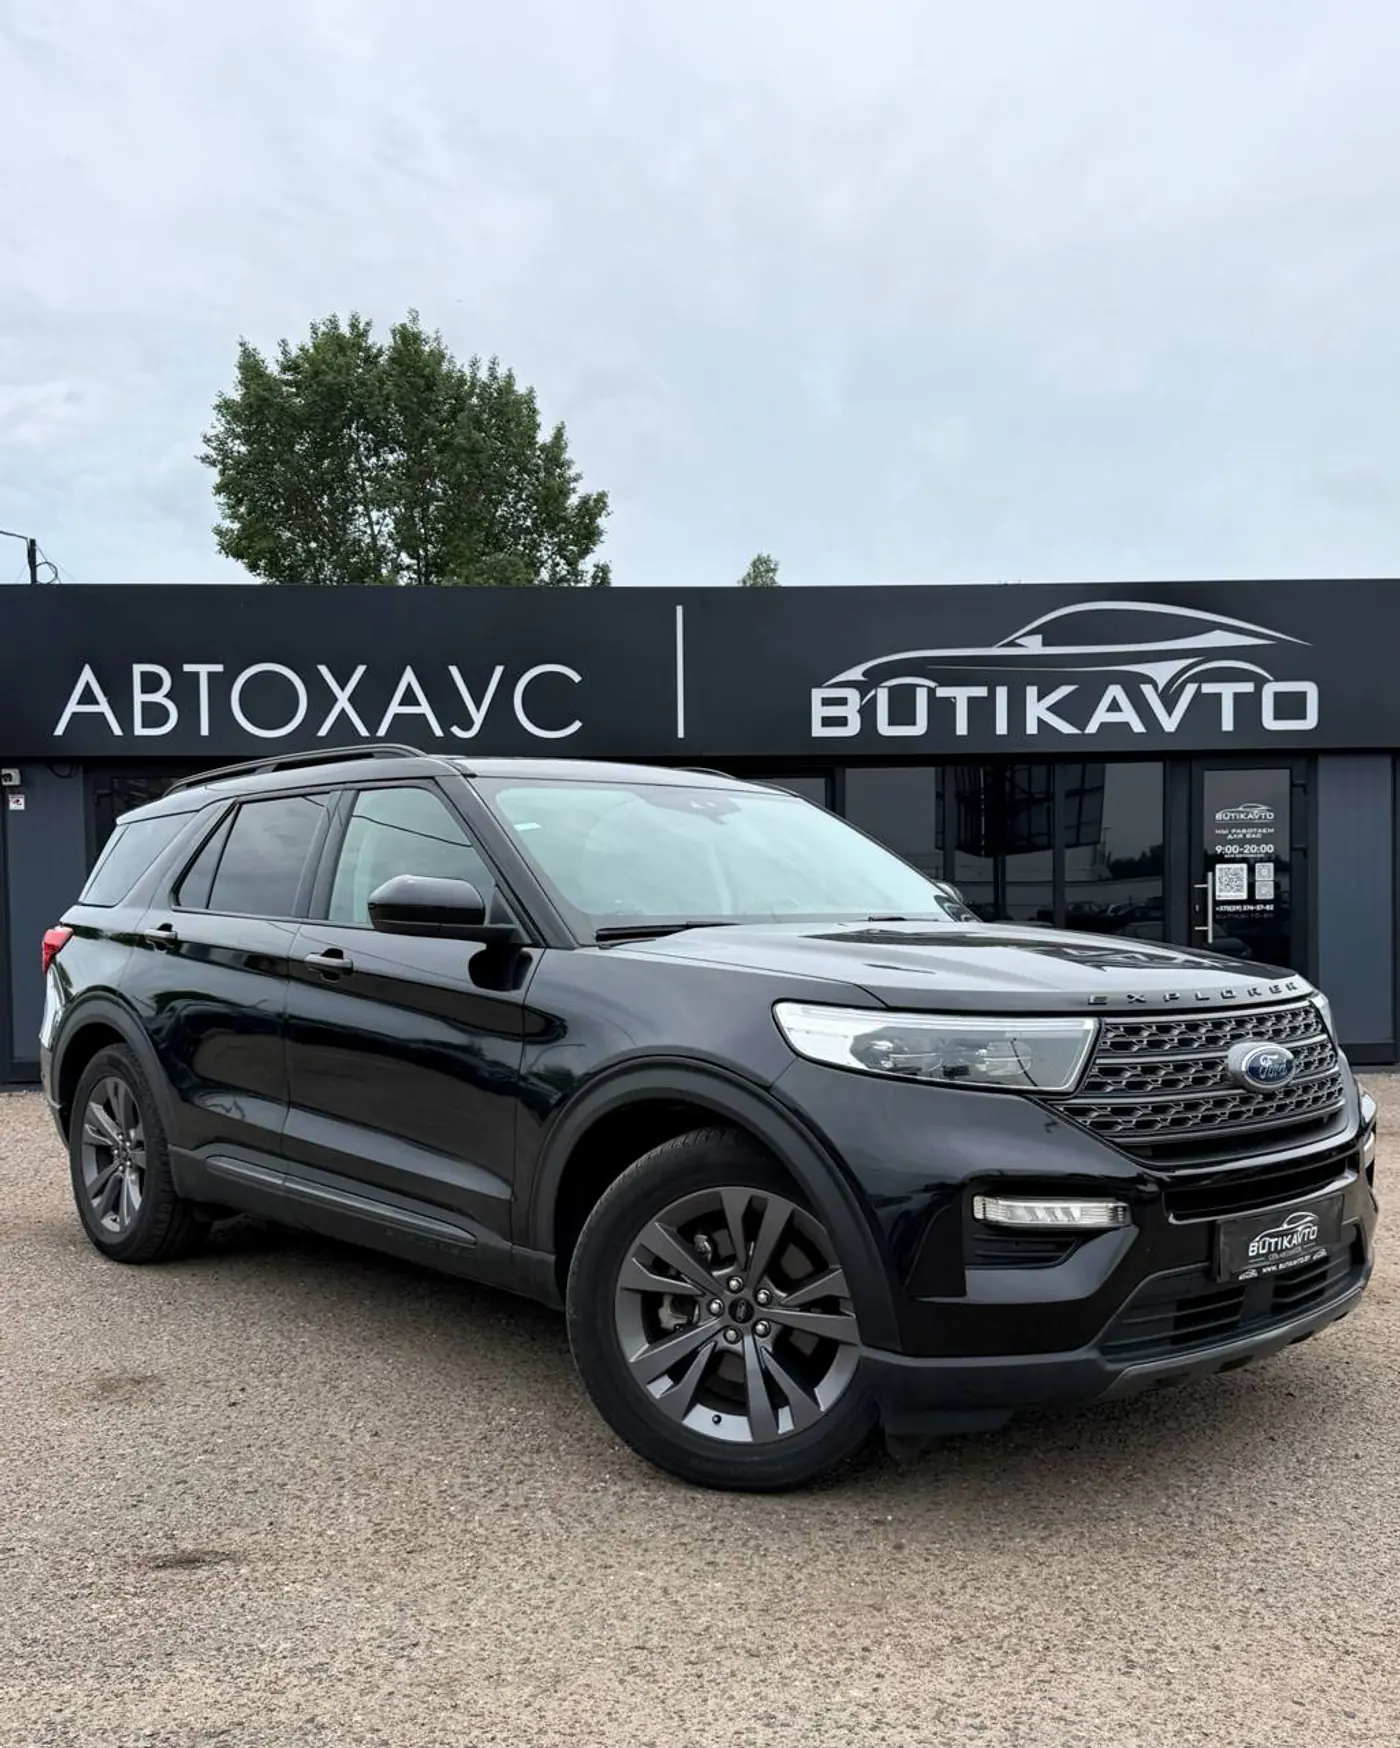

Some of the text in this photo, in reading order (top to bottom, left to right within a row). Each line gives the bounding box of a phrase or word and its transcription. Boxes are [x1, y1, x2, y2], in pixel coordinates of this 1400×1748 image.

[53, 662, 584, 739] АВТОХАУС
[810, 680, 1319, 738] BUTIKAVTO
[1215, 811, 1275, 821] BUTIKAVTO
[1215, 844, 1275, 854] 9:00-20:00
[1088, 982, 1298, 1006] EXPLORER
[1259, 1054, 1288, 1079] Ford
[1248, 1226, 1318, 1256] BUTIKAVTO
